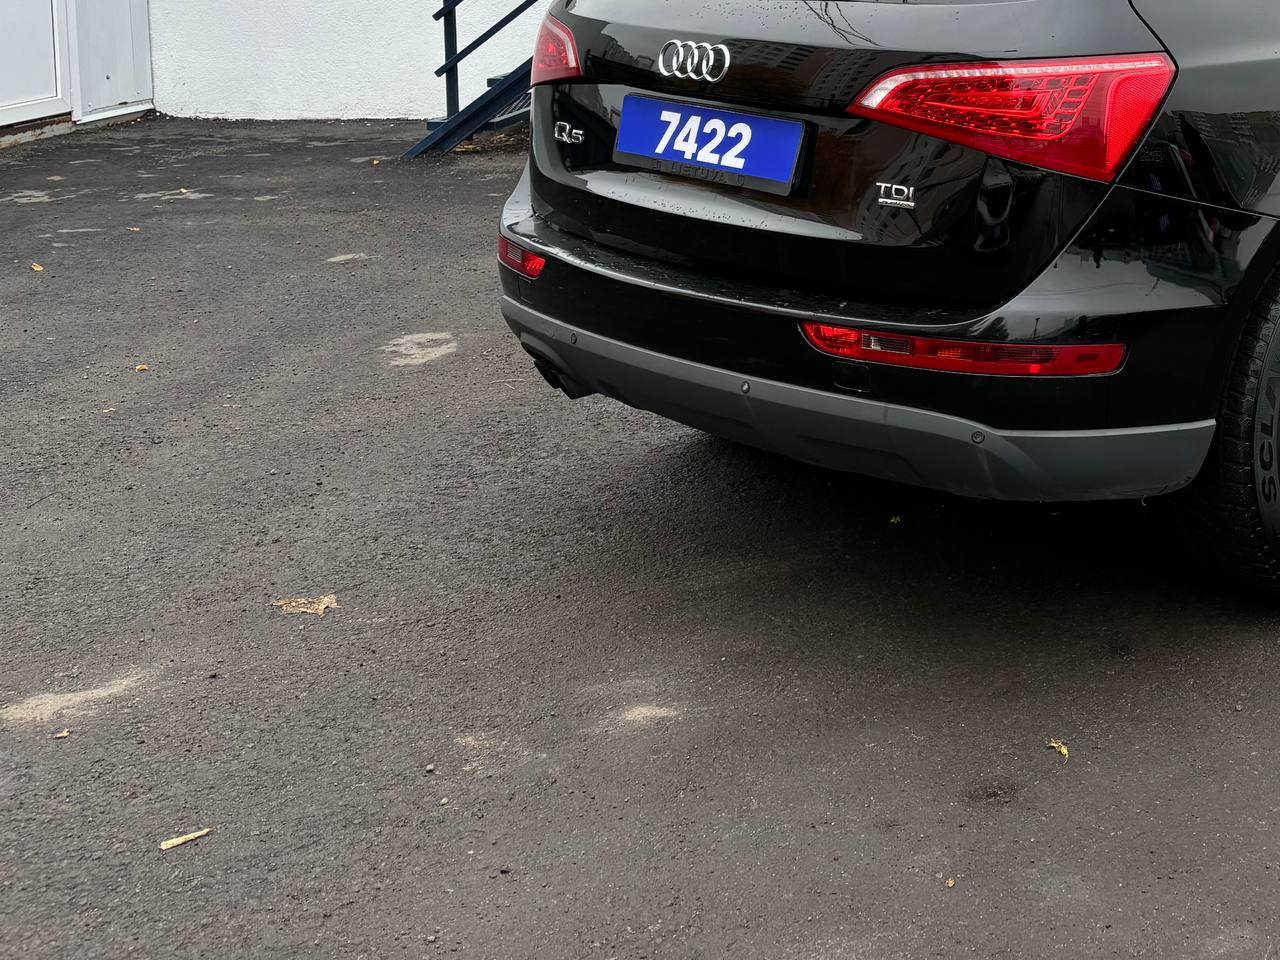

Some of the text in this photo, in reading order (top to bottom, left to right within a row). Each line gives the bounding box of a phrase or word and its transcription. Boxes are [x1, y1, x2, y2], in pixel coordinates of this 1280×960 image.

[554, 121, 584, 144] Q5
[654, 110, 752, 169] 7422
[875, 182, 915, 201] TDI
